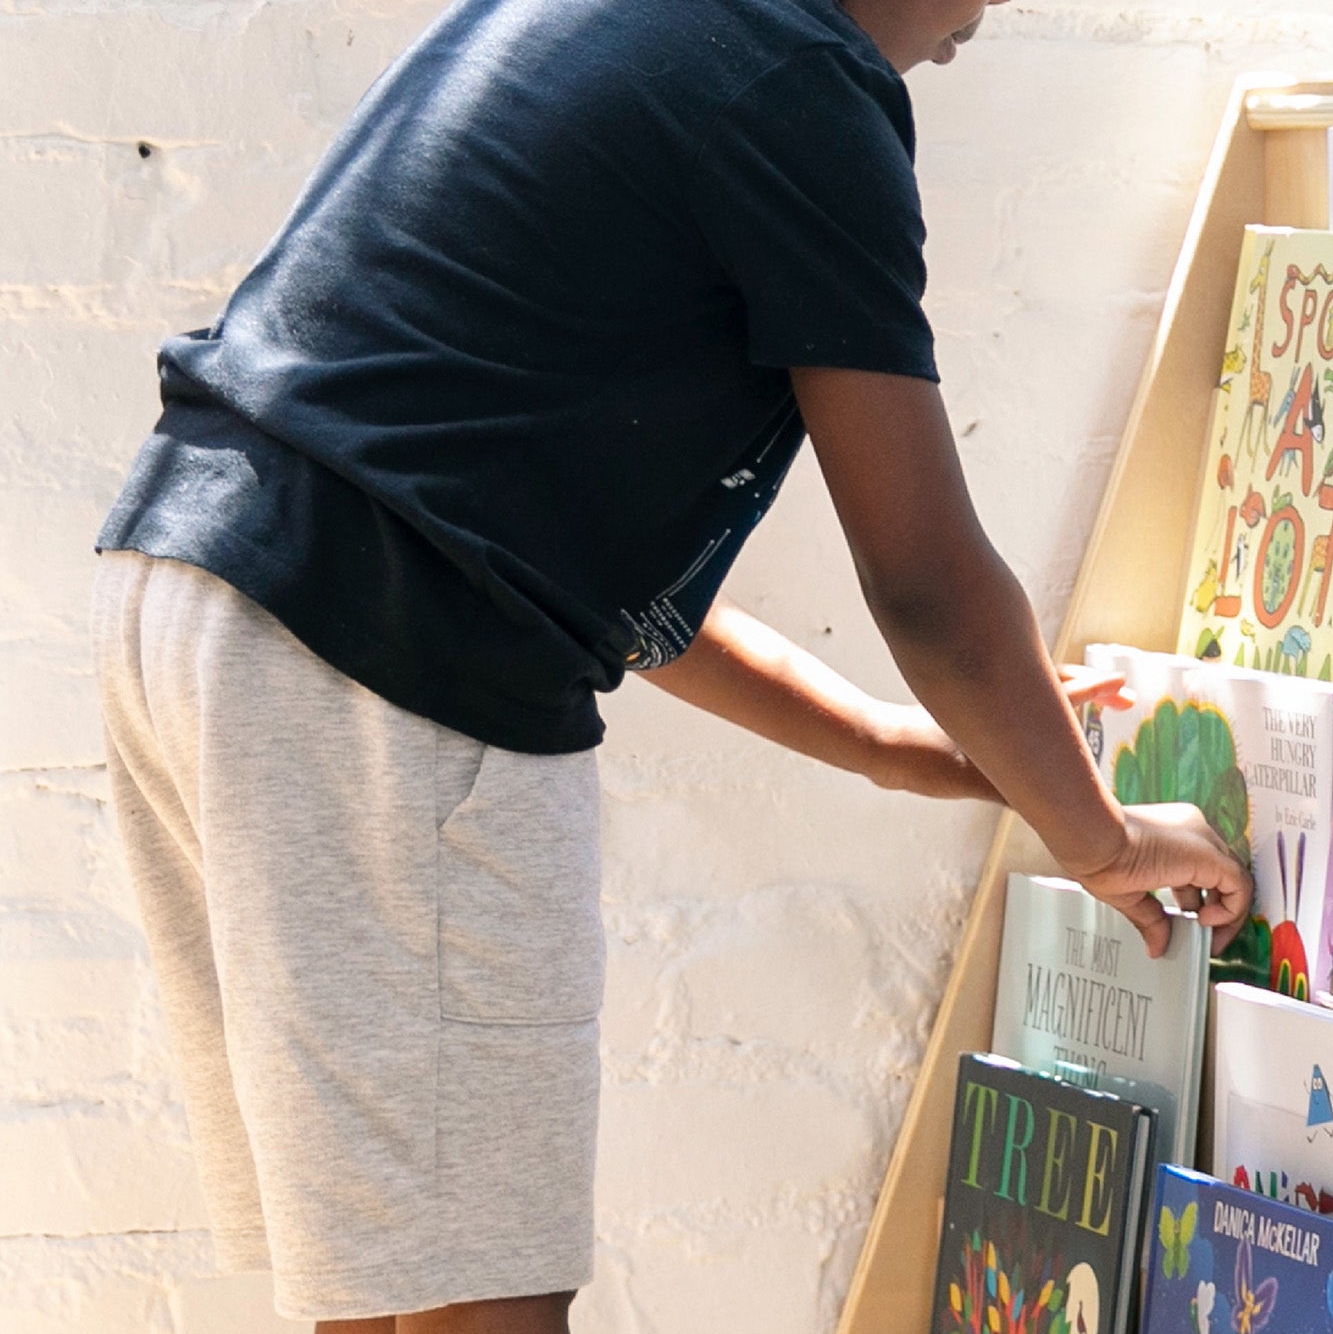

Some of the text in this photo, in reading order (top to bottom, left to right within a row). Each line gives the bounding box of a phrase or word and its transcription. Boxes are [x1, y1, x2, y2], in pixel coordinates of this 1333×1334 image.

[1266, 361, 1314, 498] A
[1065, 926, 1123, 978] THE MOST
[1022, 962, 1153, 1062] MAGNIFICENT
[960, 1080, 1118, 1237] TREE
[1213, 1200, 1256, 1246] DANICA
